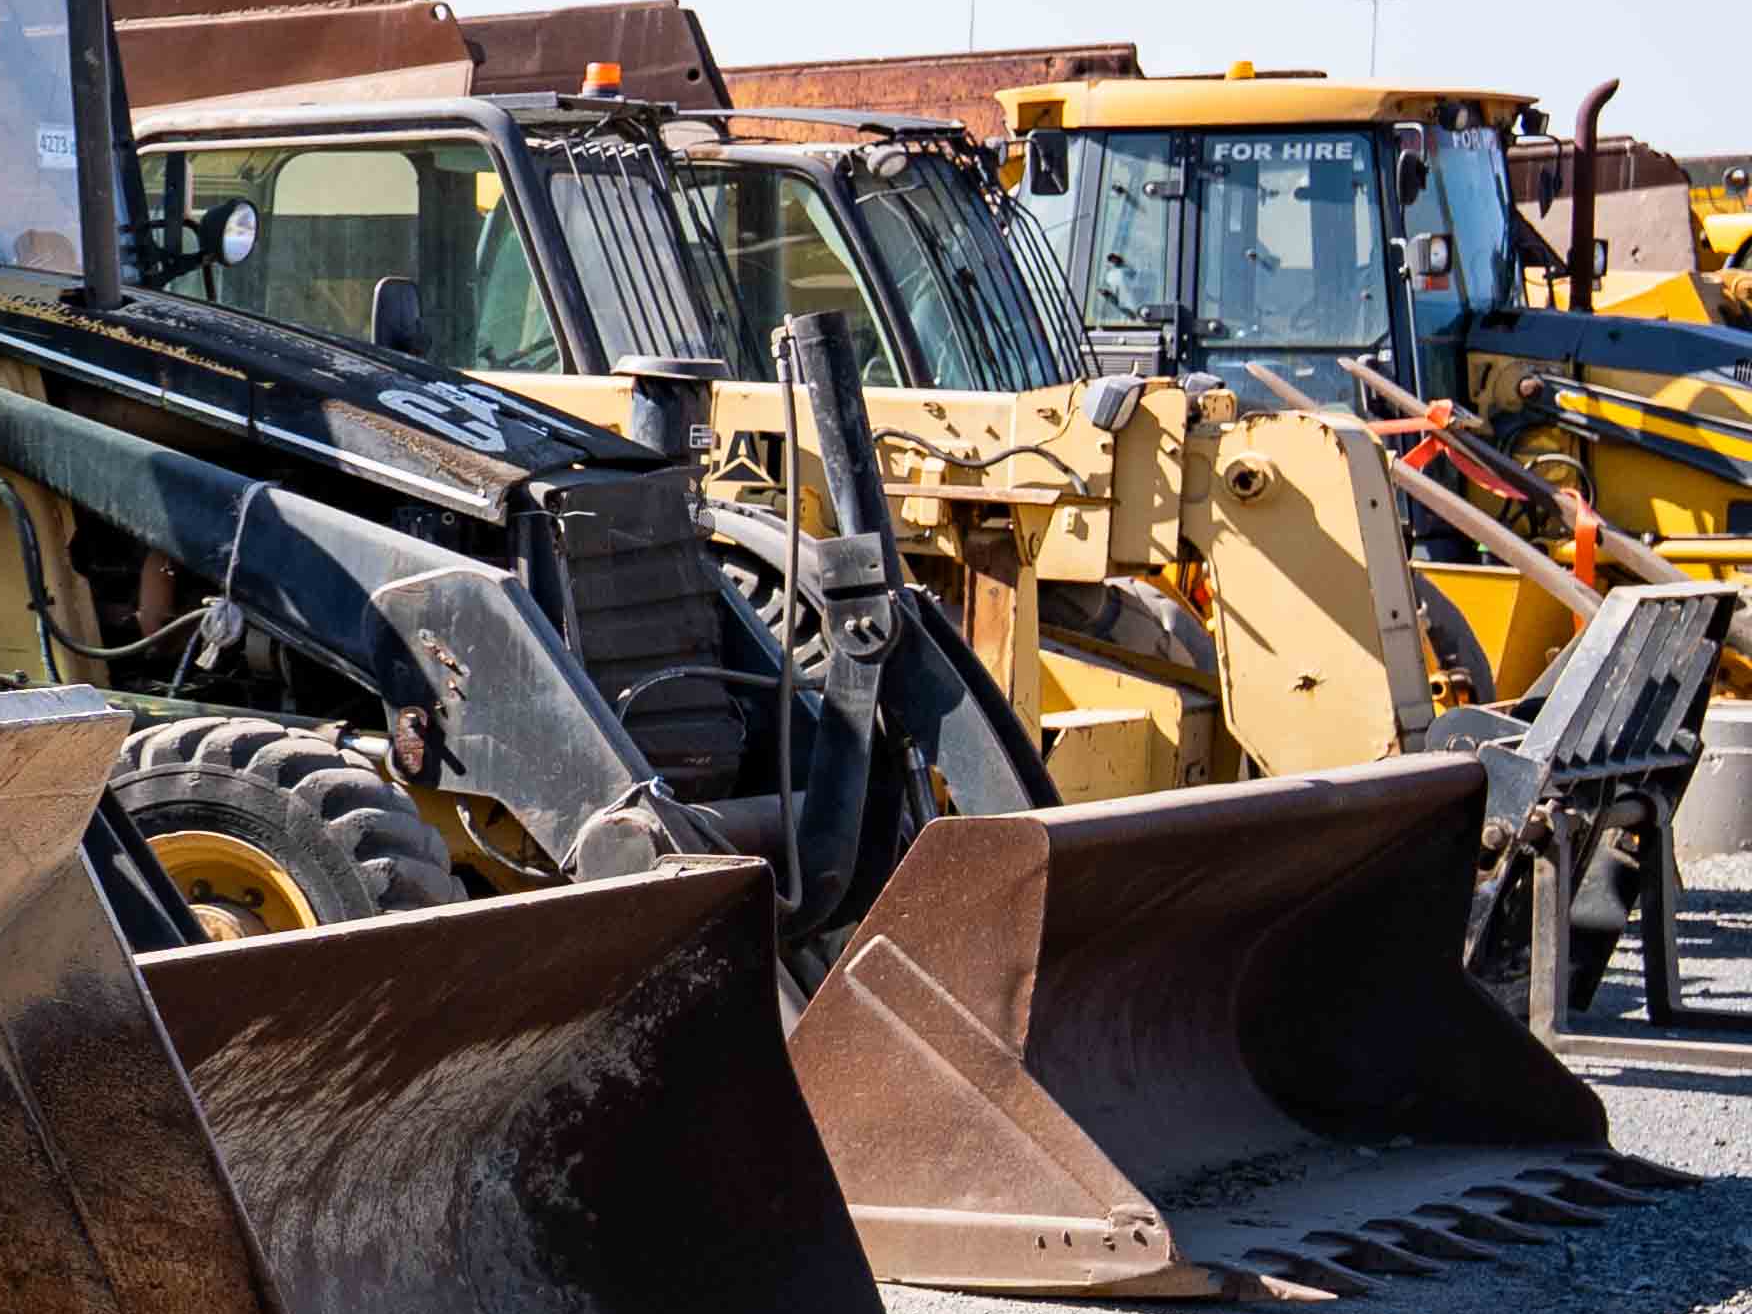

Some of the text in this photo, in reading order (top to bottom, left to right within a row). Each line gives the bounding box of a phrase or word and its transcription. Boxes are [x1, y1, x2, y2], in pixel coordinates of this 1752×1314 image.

[1214, 141, 1352, 161] FOR HIRE
[711, 430, 786, 483] AT
